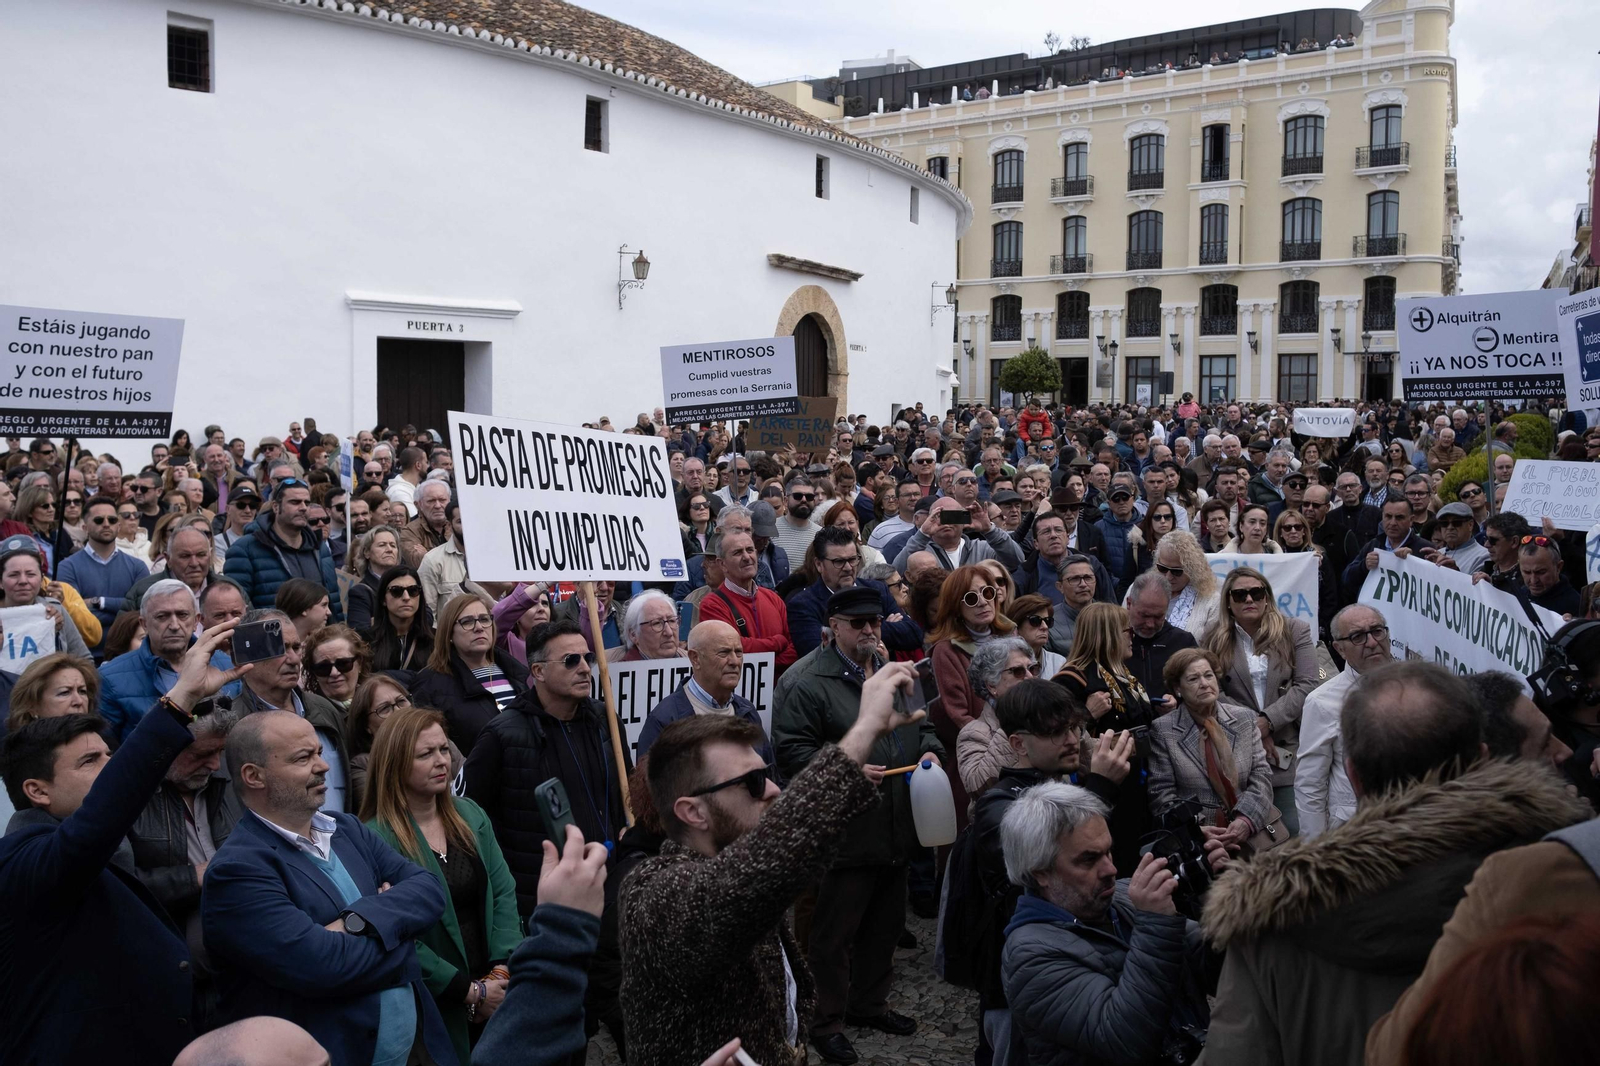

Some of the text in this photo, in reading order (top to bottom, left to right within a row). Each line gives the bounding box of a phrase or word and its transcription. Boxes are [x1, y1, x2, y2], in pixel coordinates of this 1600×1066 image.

[1559, 300, 1588, 316] Carreteras
[1589, 296, 1596, 308] de
[407, 320, 464, 333] PUERTA 3
[1437, 310, 1501, 326] Alquitrán
[18, 316, 151, 340] Estáis jugando
[8, 341, 153, 363] con nuestro pan
[682, 346, 775, 364] MENTIROSOS
[1424, 357, 1446, 371] YA
[1451, 354, 1489, 370] NOS
[1493, 353, 1546, 368] TOCA
[14, 364, 143, 381] y con el futuro
[688, 367, 772, 382] Cumplid vuestras
[0, 383, 152, 404] de nuestros hijos
[670, 388, 718, 401] promesas
[720, 387, 738, 396] con
[740, 383, 749, 393] la
[1521, 387, 1554, 396] AUTOVÍA
[41, 416, 91, 426] URGENTE
[132, 418, 159, 426] A-397
[752, 416, 832, 432] CARRETERA
[1300, 415, 1350, 425] AUTOVÍA
[50, 426, 107, 435] CARRETERAS
[115, 426, 150, 435] AUTOVÍA
[761, 432, 825, 447] DEL PAN
[459, 422, 666, 499] BASTA DE PROMESAS
[1522, 464, 1537, 480] EL
[507, 509, 650, 572] INCUMPLIDAS
[1419, 581, 1441, 623] LAS
[618, 671, 640, 724] EL
[741, 661, 768, 711] DE
